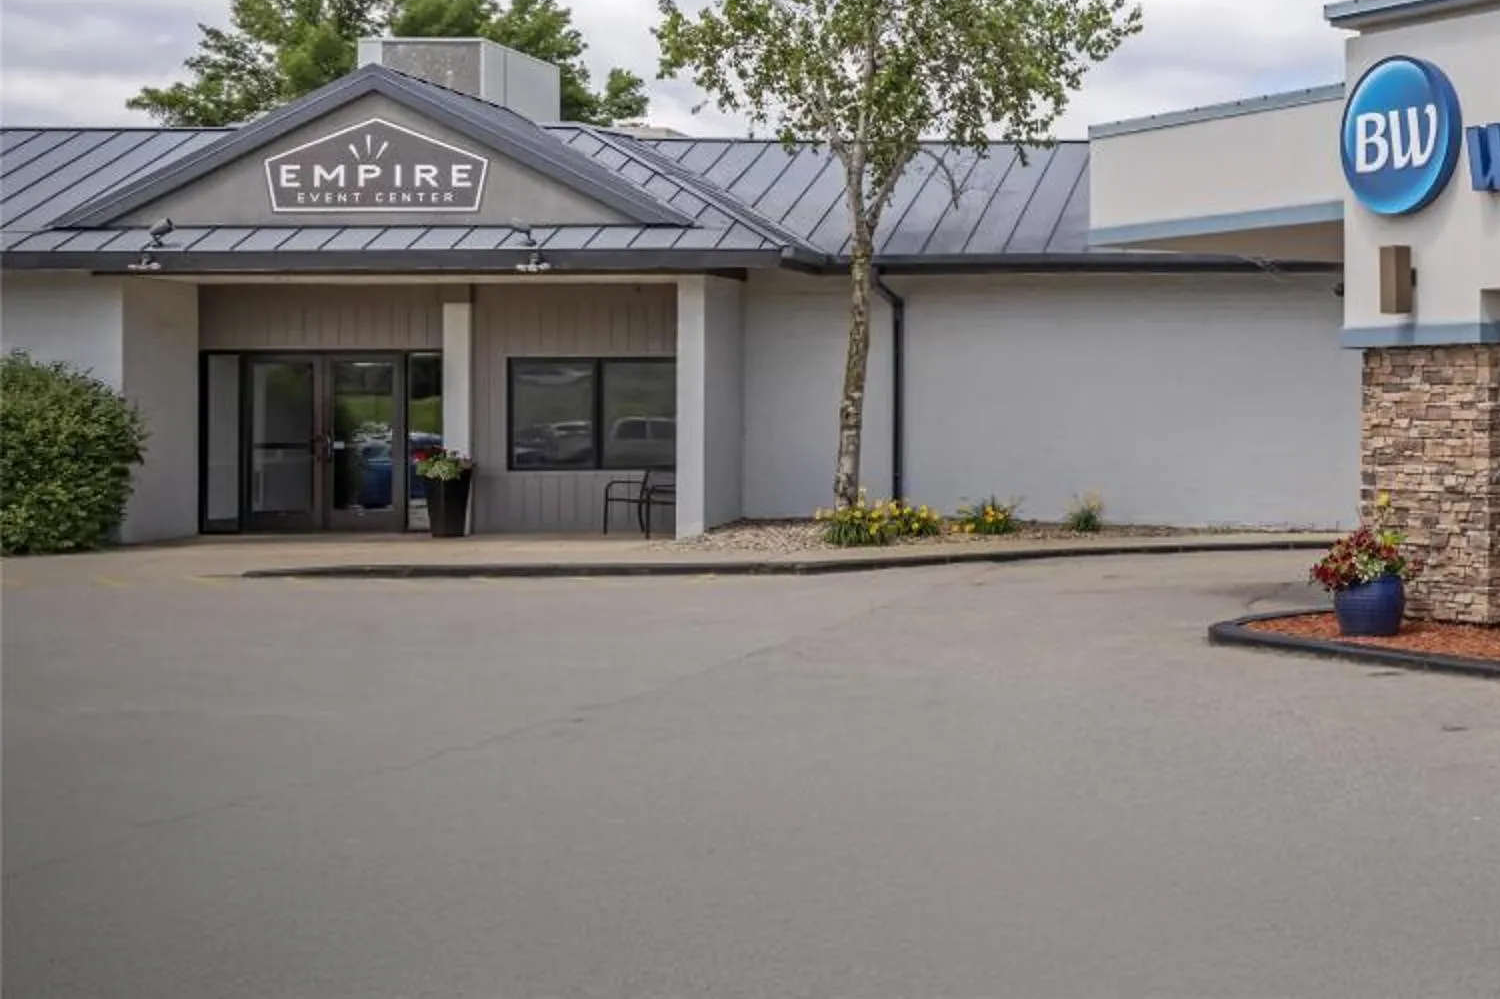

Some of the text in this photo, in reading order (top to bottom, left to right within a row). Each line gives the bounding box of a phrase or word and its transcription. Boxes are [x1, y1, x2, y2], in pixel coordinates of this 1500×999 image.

[1354, 104, 1438, 174] BW
[279, 164, 473, 188] EMPIRE
[296, 192, 454, 202] EVENT CENTER
